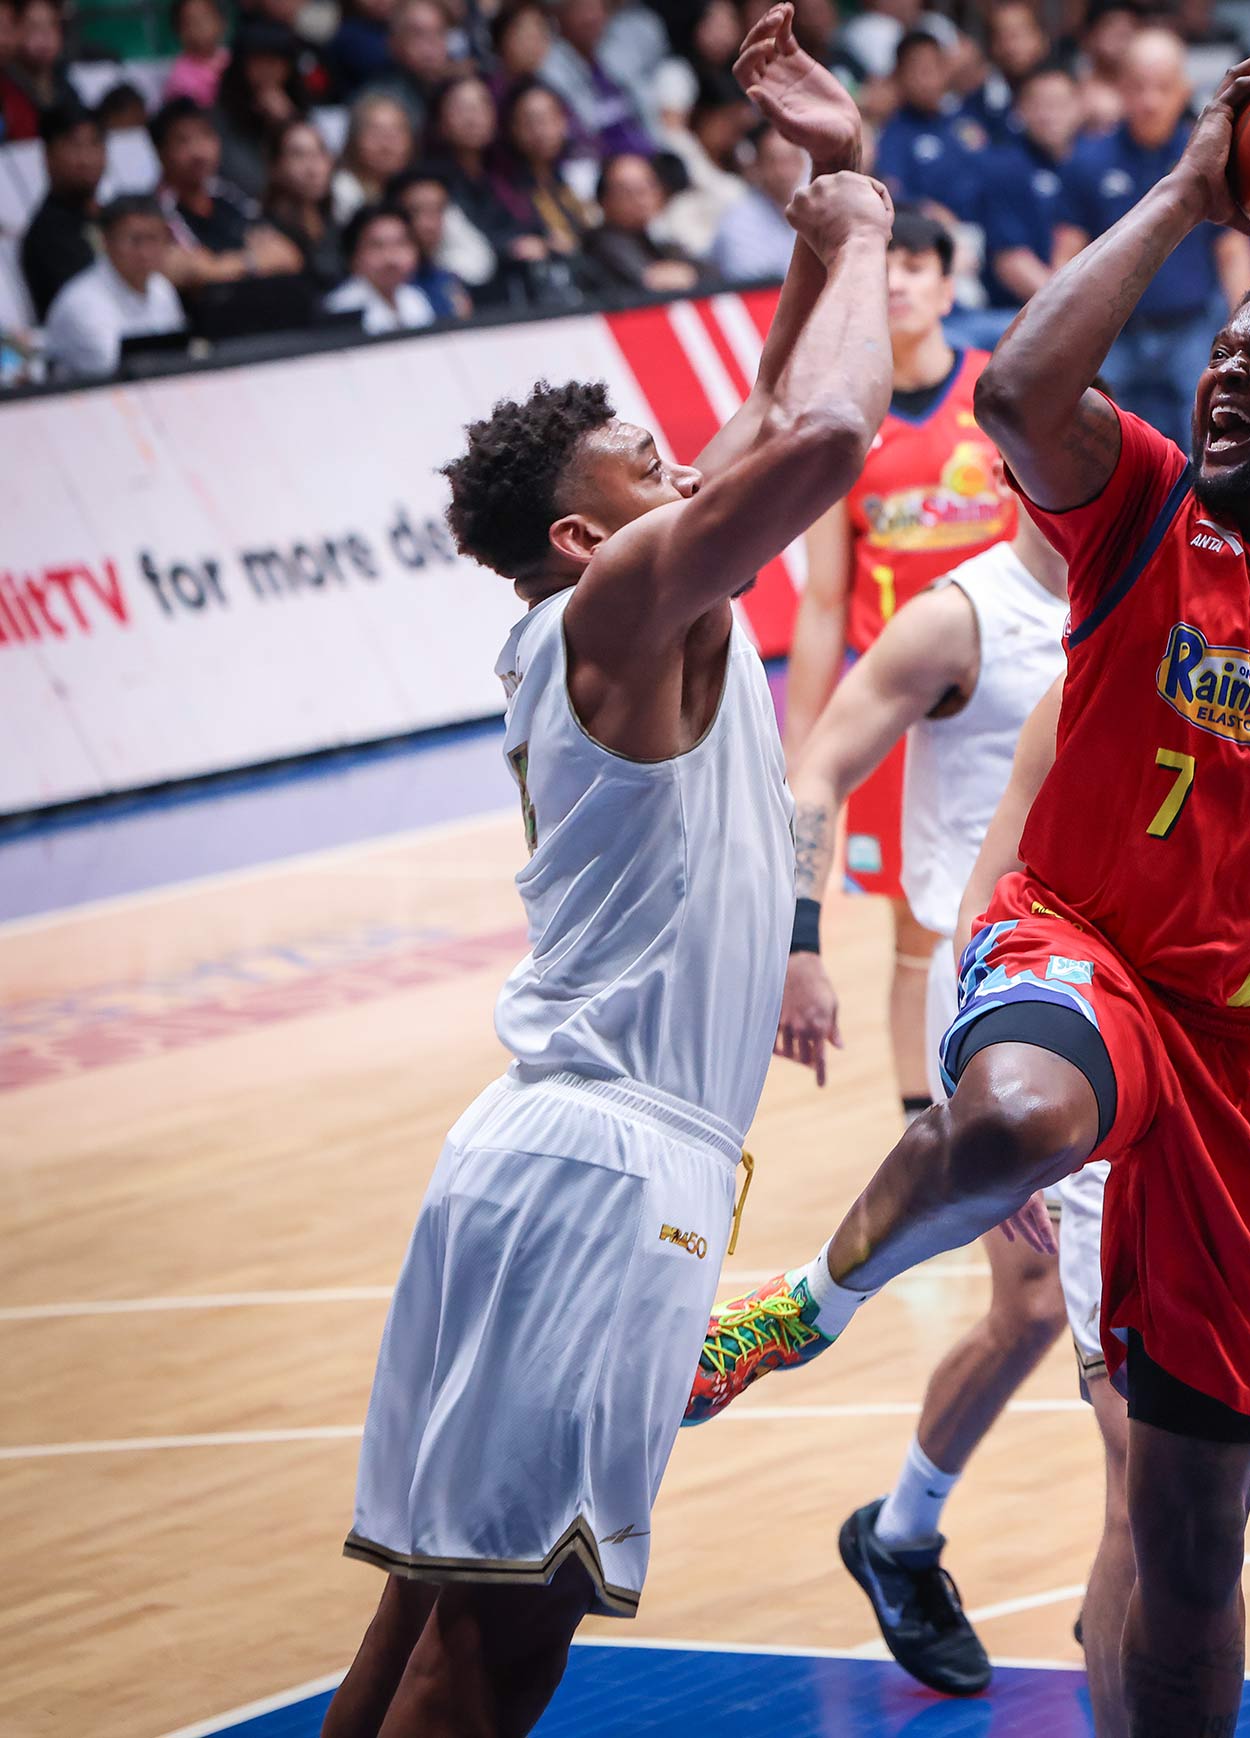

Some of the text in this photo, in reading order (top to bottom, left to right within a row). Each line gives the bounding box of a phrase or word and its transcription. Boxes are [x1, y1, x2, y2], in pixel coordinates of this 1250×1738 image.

[140, 551, 228, 614] for
[243, 533, 377, 598] more
[1190, 533, 1224, 553] ANTA
[1146, 748, 1197, 840] 7
